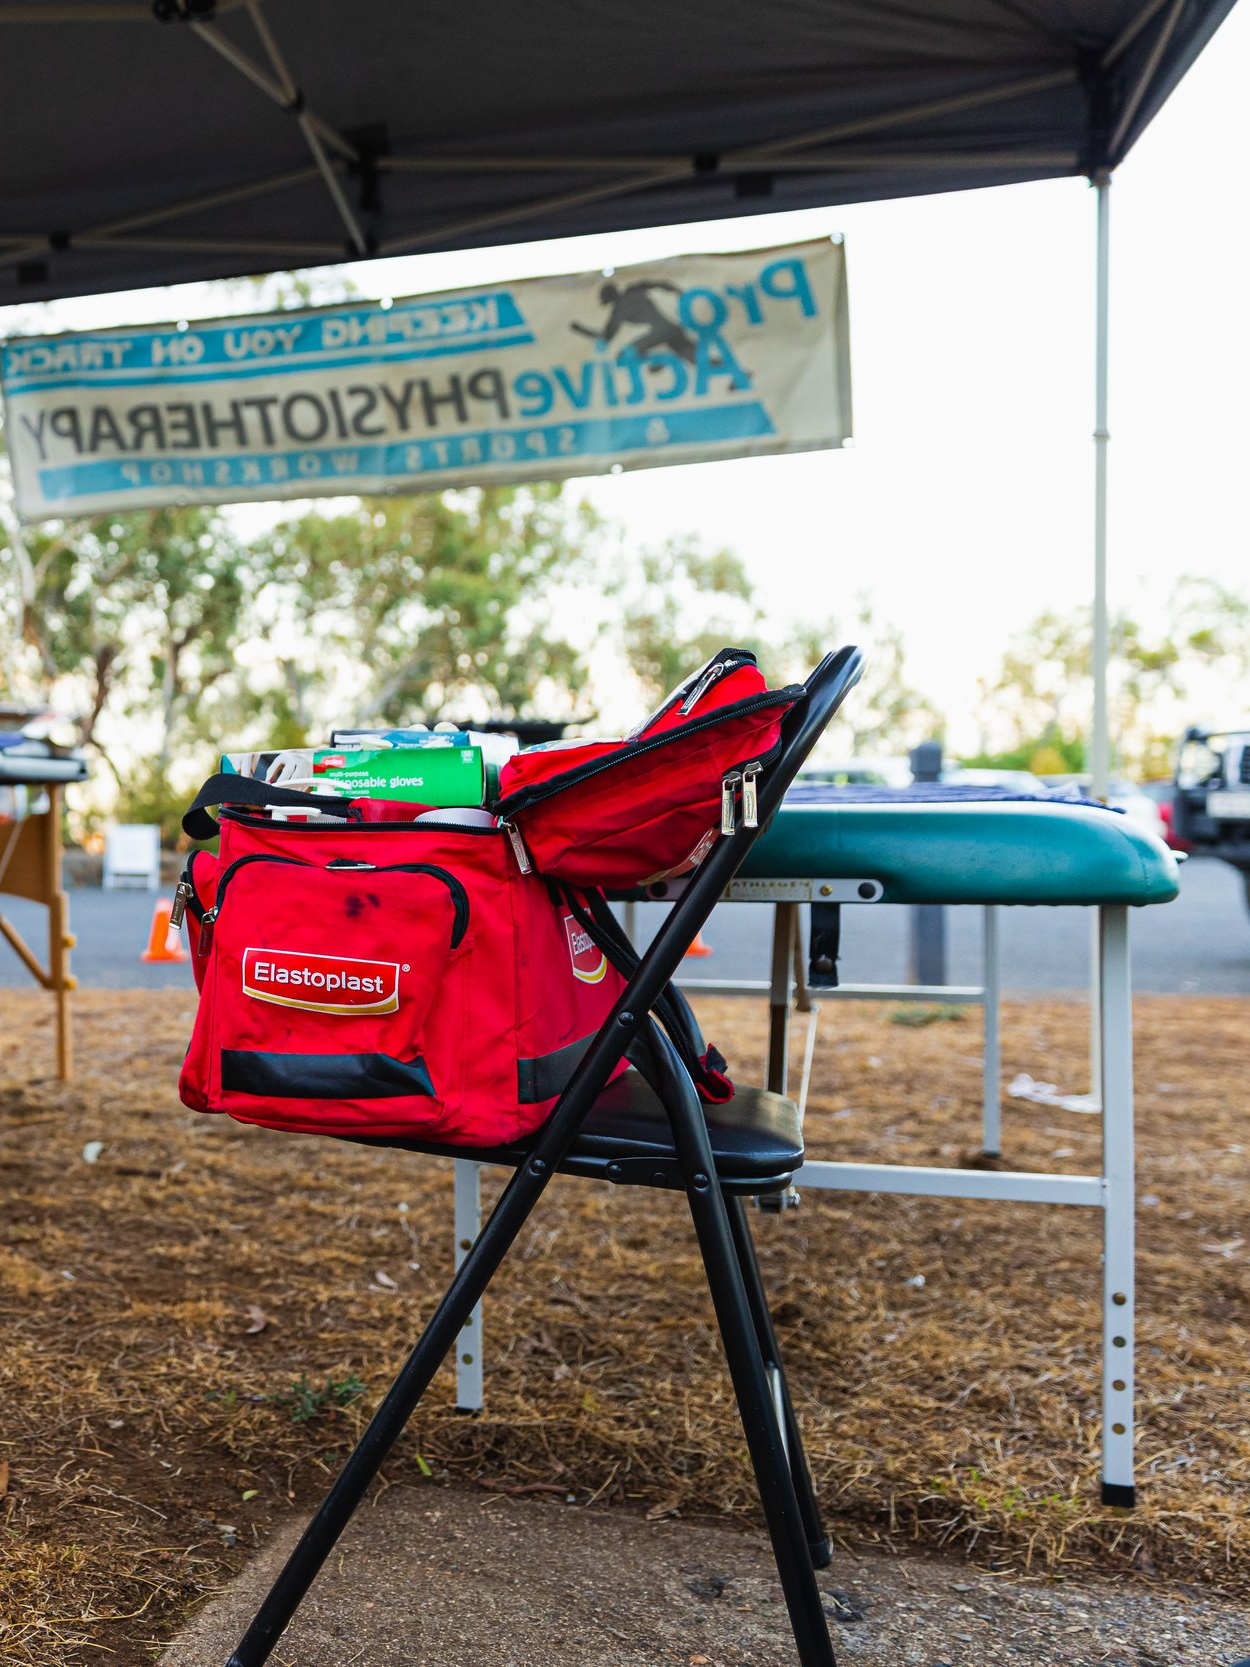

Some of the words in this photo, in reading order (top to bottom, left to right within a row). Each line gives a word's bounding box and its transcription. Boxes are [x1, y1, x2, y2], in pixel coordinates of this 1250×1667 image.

[333, 776, 387, 788] posable
[389, 776, 424, 789] gloves
[254, 961, 384, 995] Elastoplast
